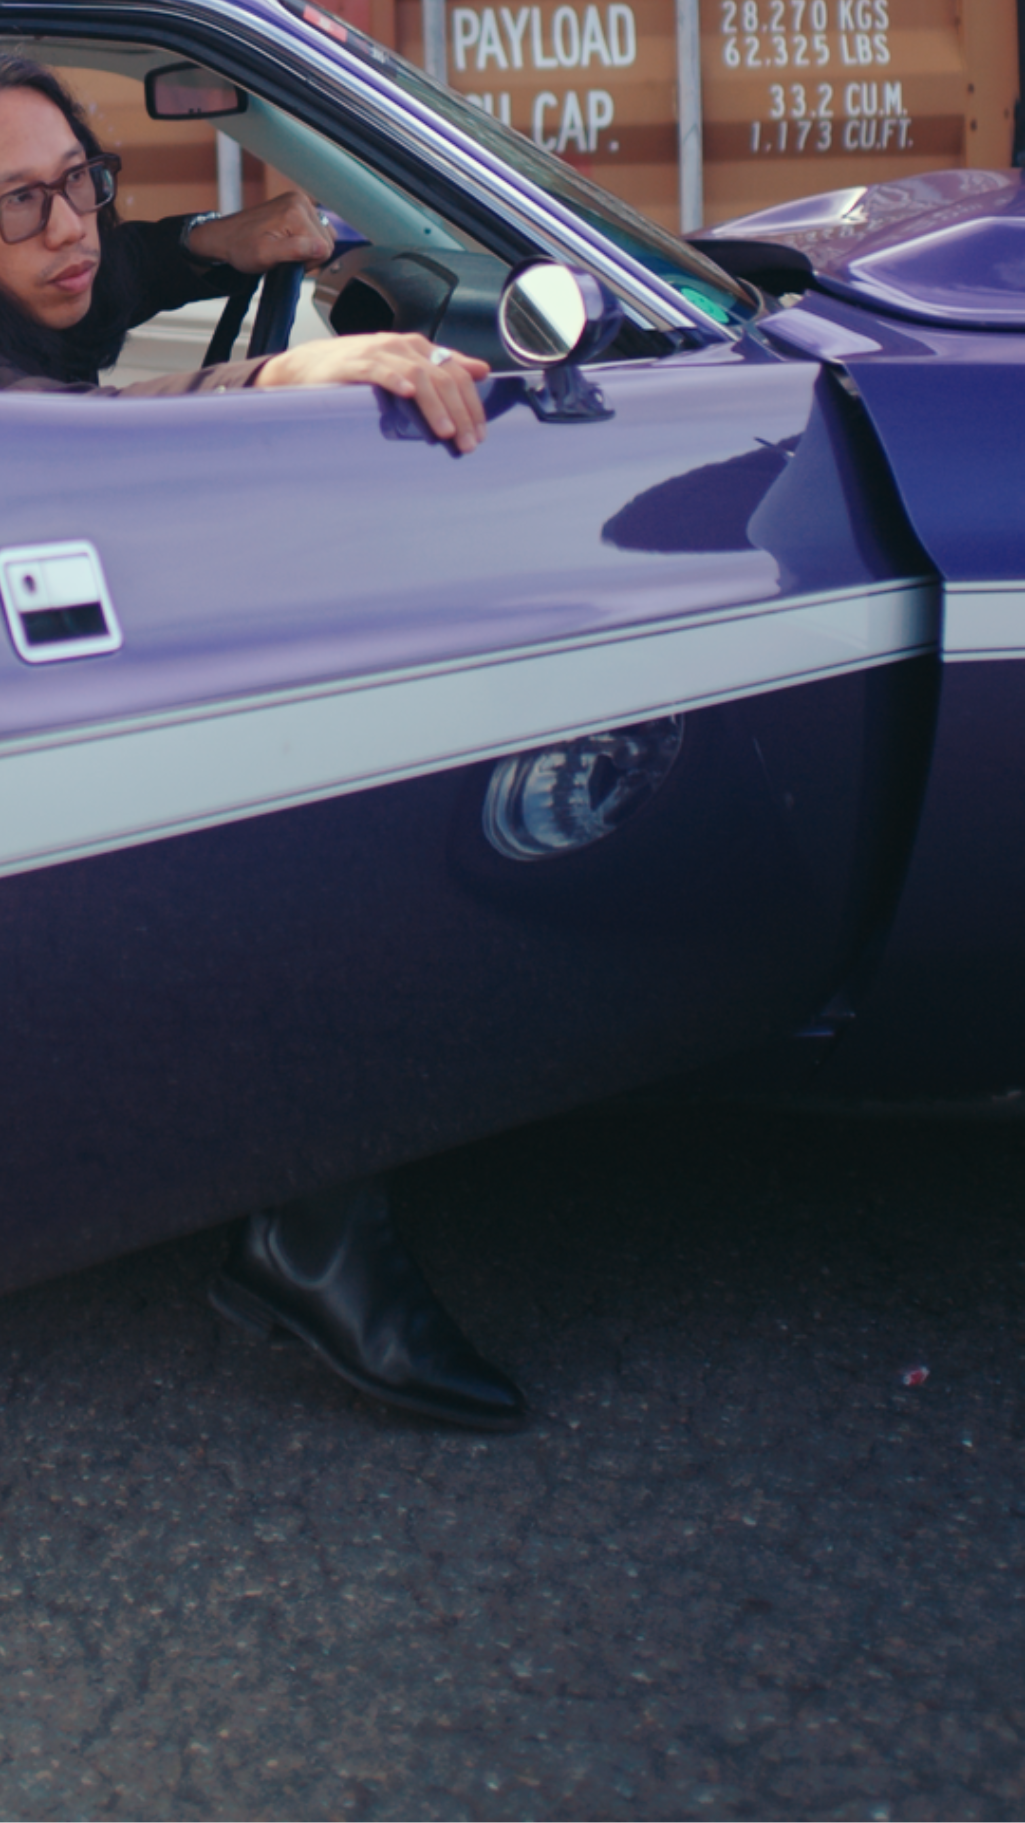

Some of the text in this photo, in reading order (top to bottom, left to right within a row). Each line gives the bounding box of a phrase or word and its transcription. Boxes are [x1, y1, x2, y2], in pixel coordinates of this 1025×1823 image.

[452, 4, 637, 71] PAYLOAD
[841, 34, 890, 65] LBS
[770, 82, 909, 118] 33.2 CU.M.
[533, 89, 620, 154] CAP.
[845, 119, 914, 150] CU.FT.
